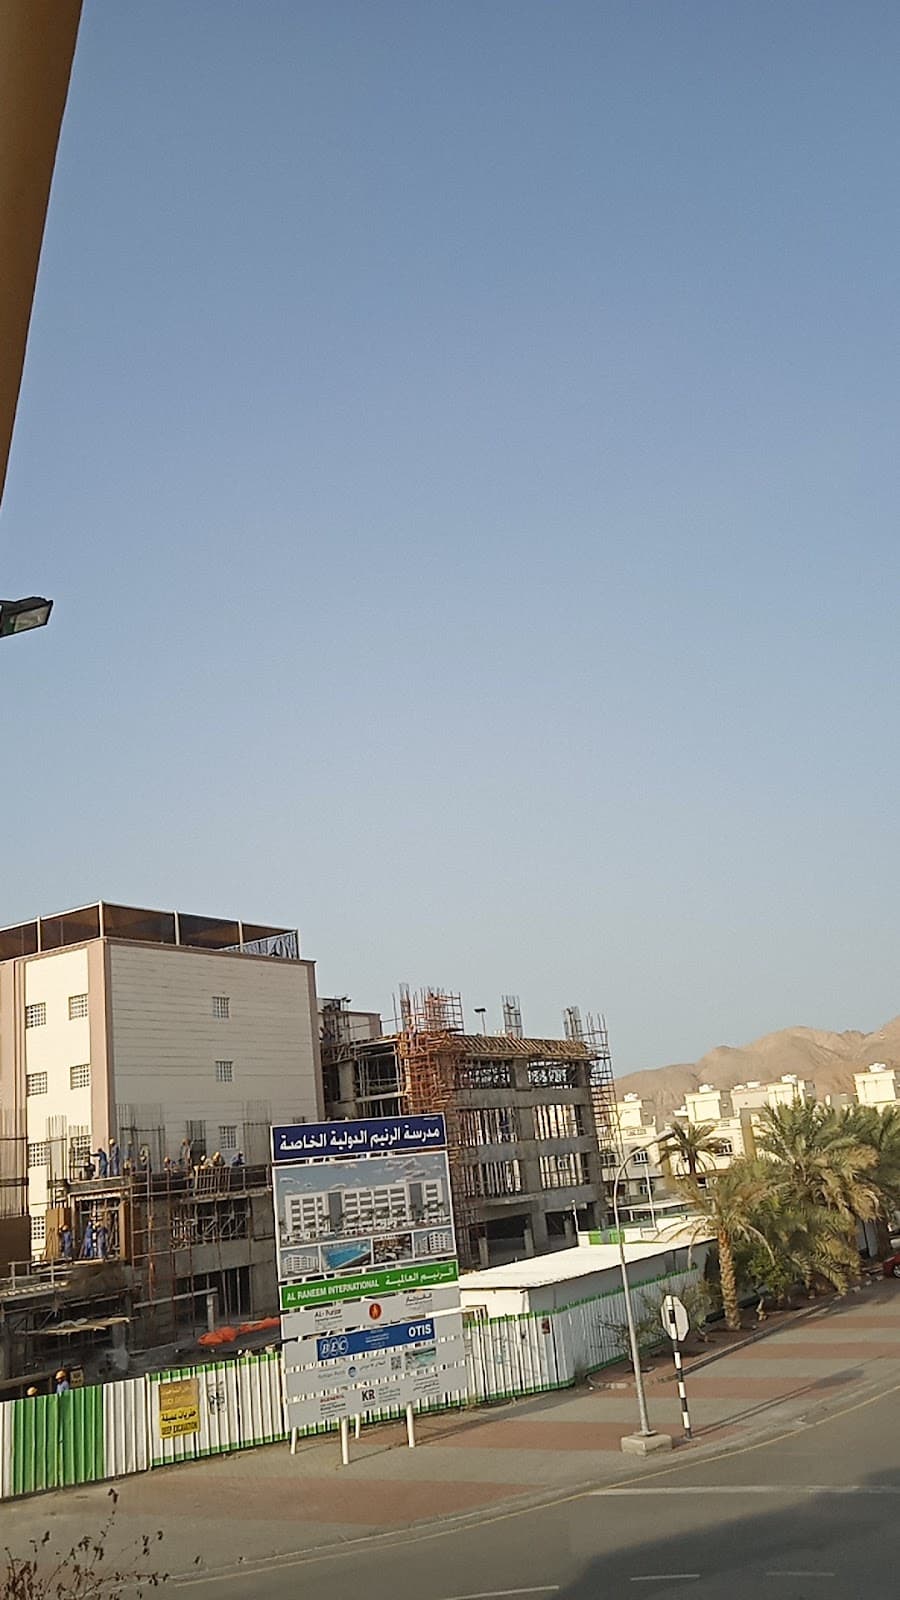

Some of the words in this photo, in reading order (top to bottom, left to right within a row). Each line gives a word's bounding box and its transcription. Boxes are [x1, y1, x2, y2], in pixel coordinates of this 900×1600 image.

[279, 1133, 327, 1151] الخاصة
[330, 1129, 368, 1151] الدولية
[370, 1126, 401, 1148] الرنيم
[404, 1124, 440, 1143] مدرسة
[385, 1272, 419, 1287] العالمية
[287, 1291, 297, 1303] AL
[327, 1279, 380, 1295] INTERNATIONAL
[408, 1323, 432, 1338] OTIS
[321, 1338, 348, 1356] BEC
[361, 1389, 376, 1402] KR
